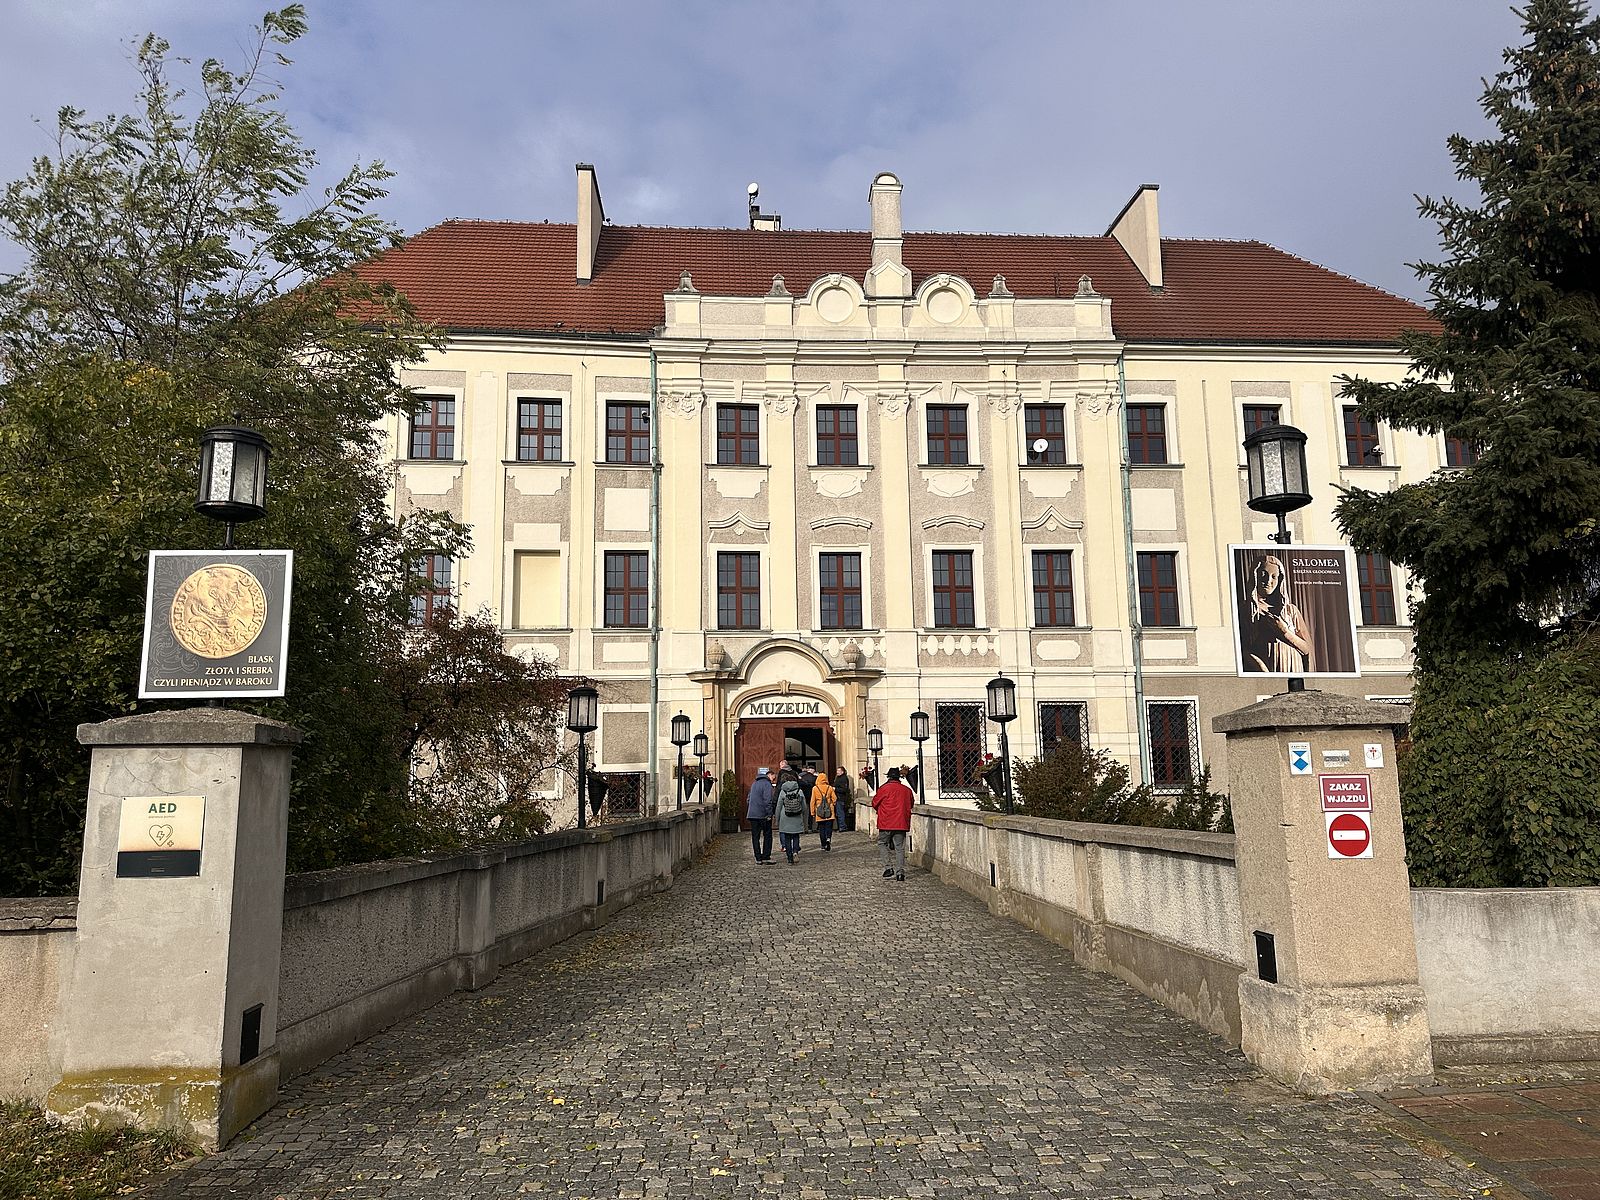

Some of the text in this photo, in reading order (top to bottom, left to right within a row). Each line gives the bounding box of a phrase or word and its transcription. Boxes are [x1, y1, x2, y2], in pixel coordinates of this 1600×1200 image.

[1292, 558, 1340, 567] SALOMEA
[248, 655, 274, 664] BLASK
[205, 667, 234, 675] ZŁOTA
[242, 666, 273, 674] SREBRA
[153, 678, 178, 687] CZYLI
[180, 678, 222, 688] PIENIĄDZ
[236, 677, 272, 686] BAROKU
[749, 702, 820, 715] MUZEUM
[1329, 783, 1362, 791] ZAKAZ
[1326, 795, 1366, 803] WJAZDU
[148, 802, 177, 813] AED
